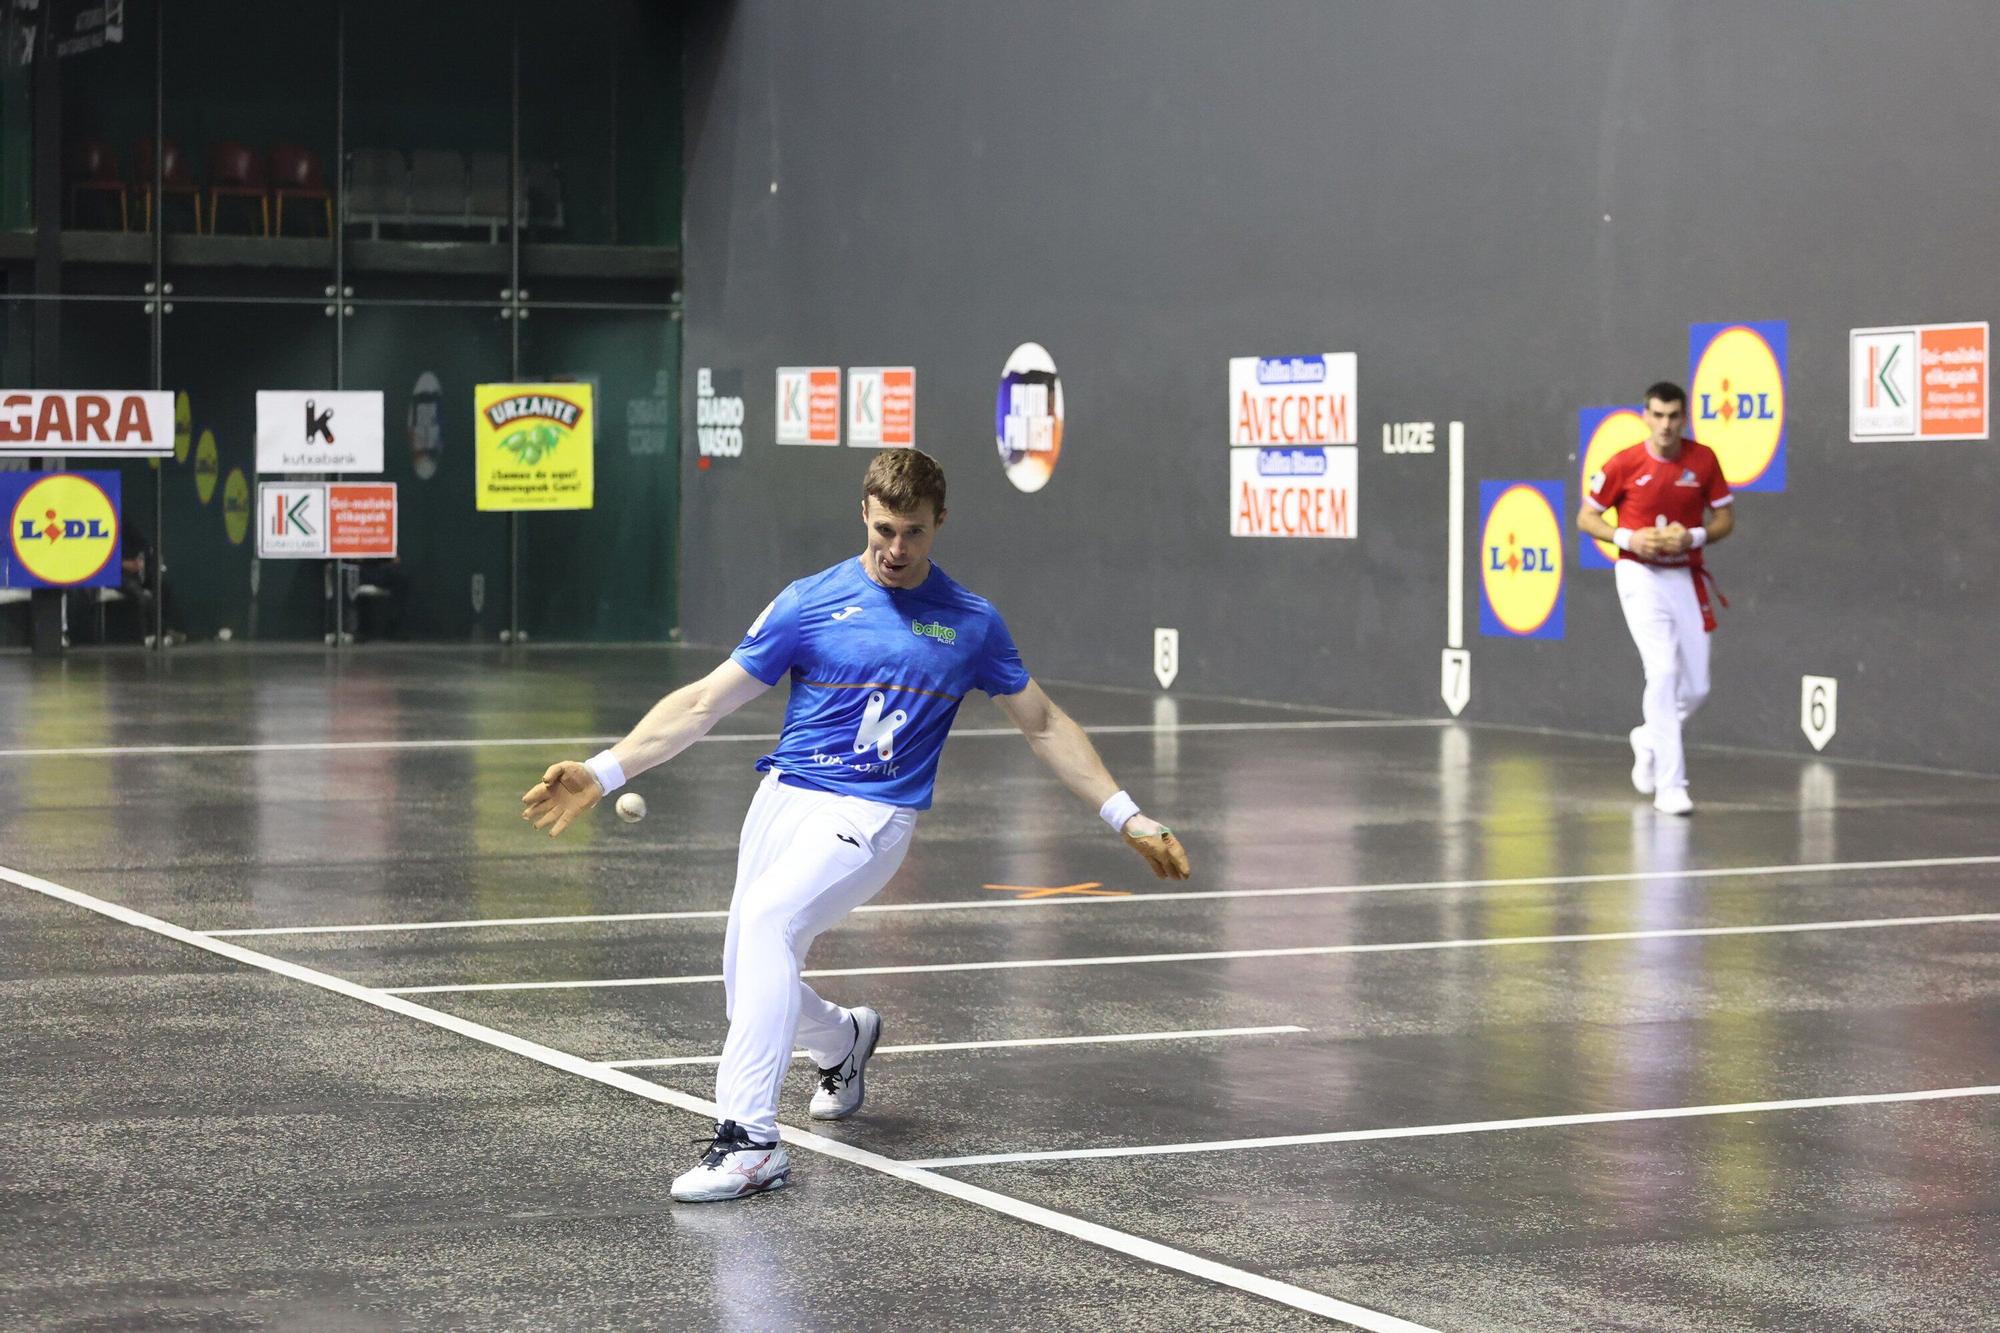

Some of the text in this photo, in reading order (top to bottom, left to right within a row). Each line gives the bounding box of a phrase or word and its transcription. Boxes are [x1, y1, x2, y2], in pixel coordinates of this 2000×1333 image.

[697, 368, 714, 397] EL
[0, 394, 153, 443] GARA
[489, 396, 578, 425] URZANTE
[697, 397, 744, 426] DIARIO
[1236, 390, 1347, 443] AVECREM
[698, 427, 743, 458] VASCO
[1382, 421, 1435, 454] LUZE
[1237, 481, 1348, 535] AVECREM
[912, 619, 956, 640] baiko
[1452, 658, 1463, 699] 7
[1810, 685, 1827, 732] 6
